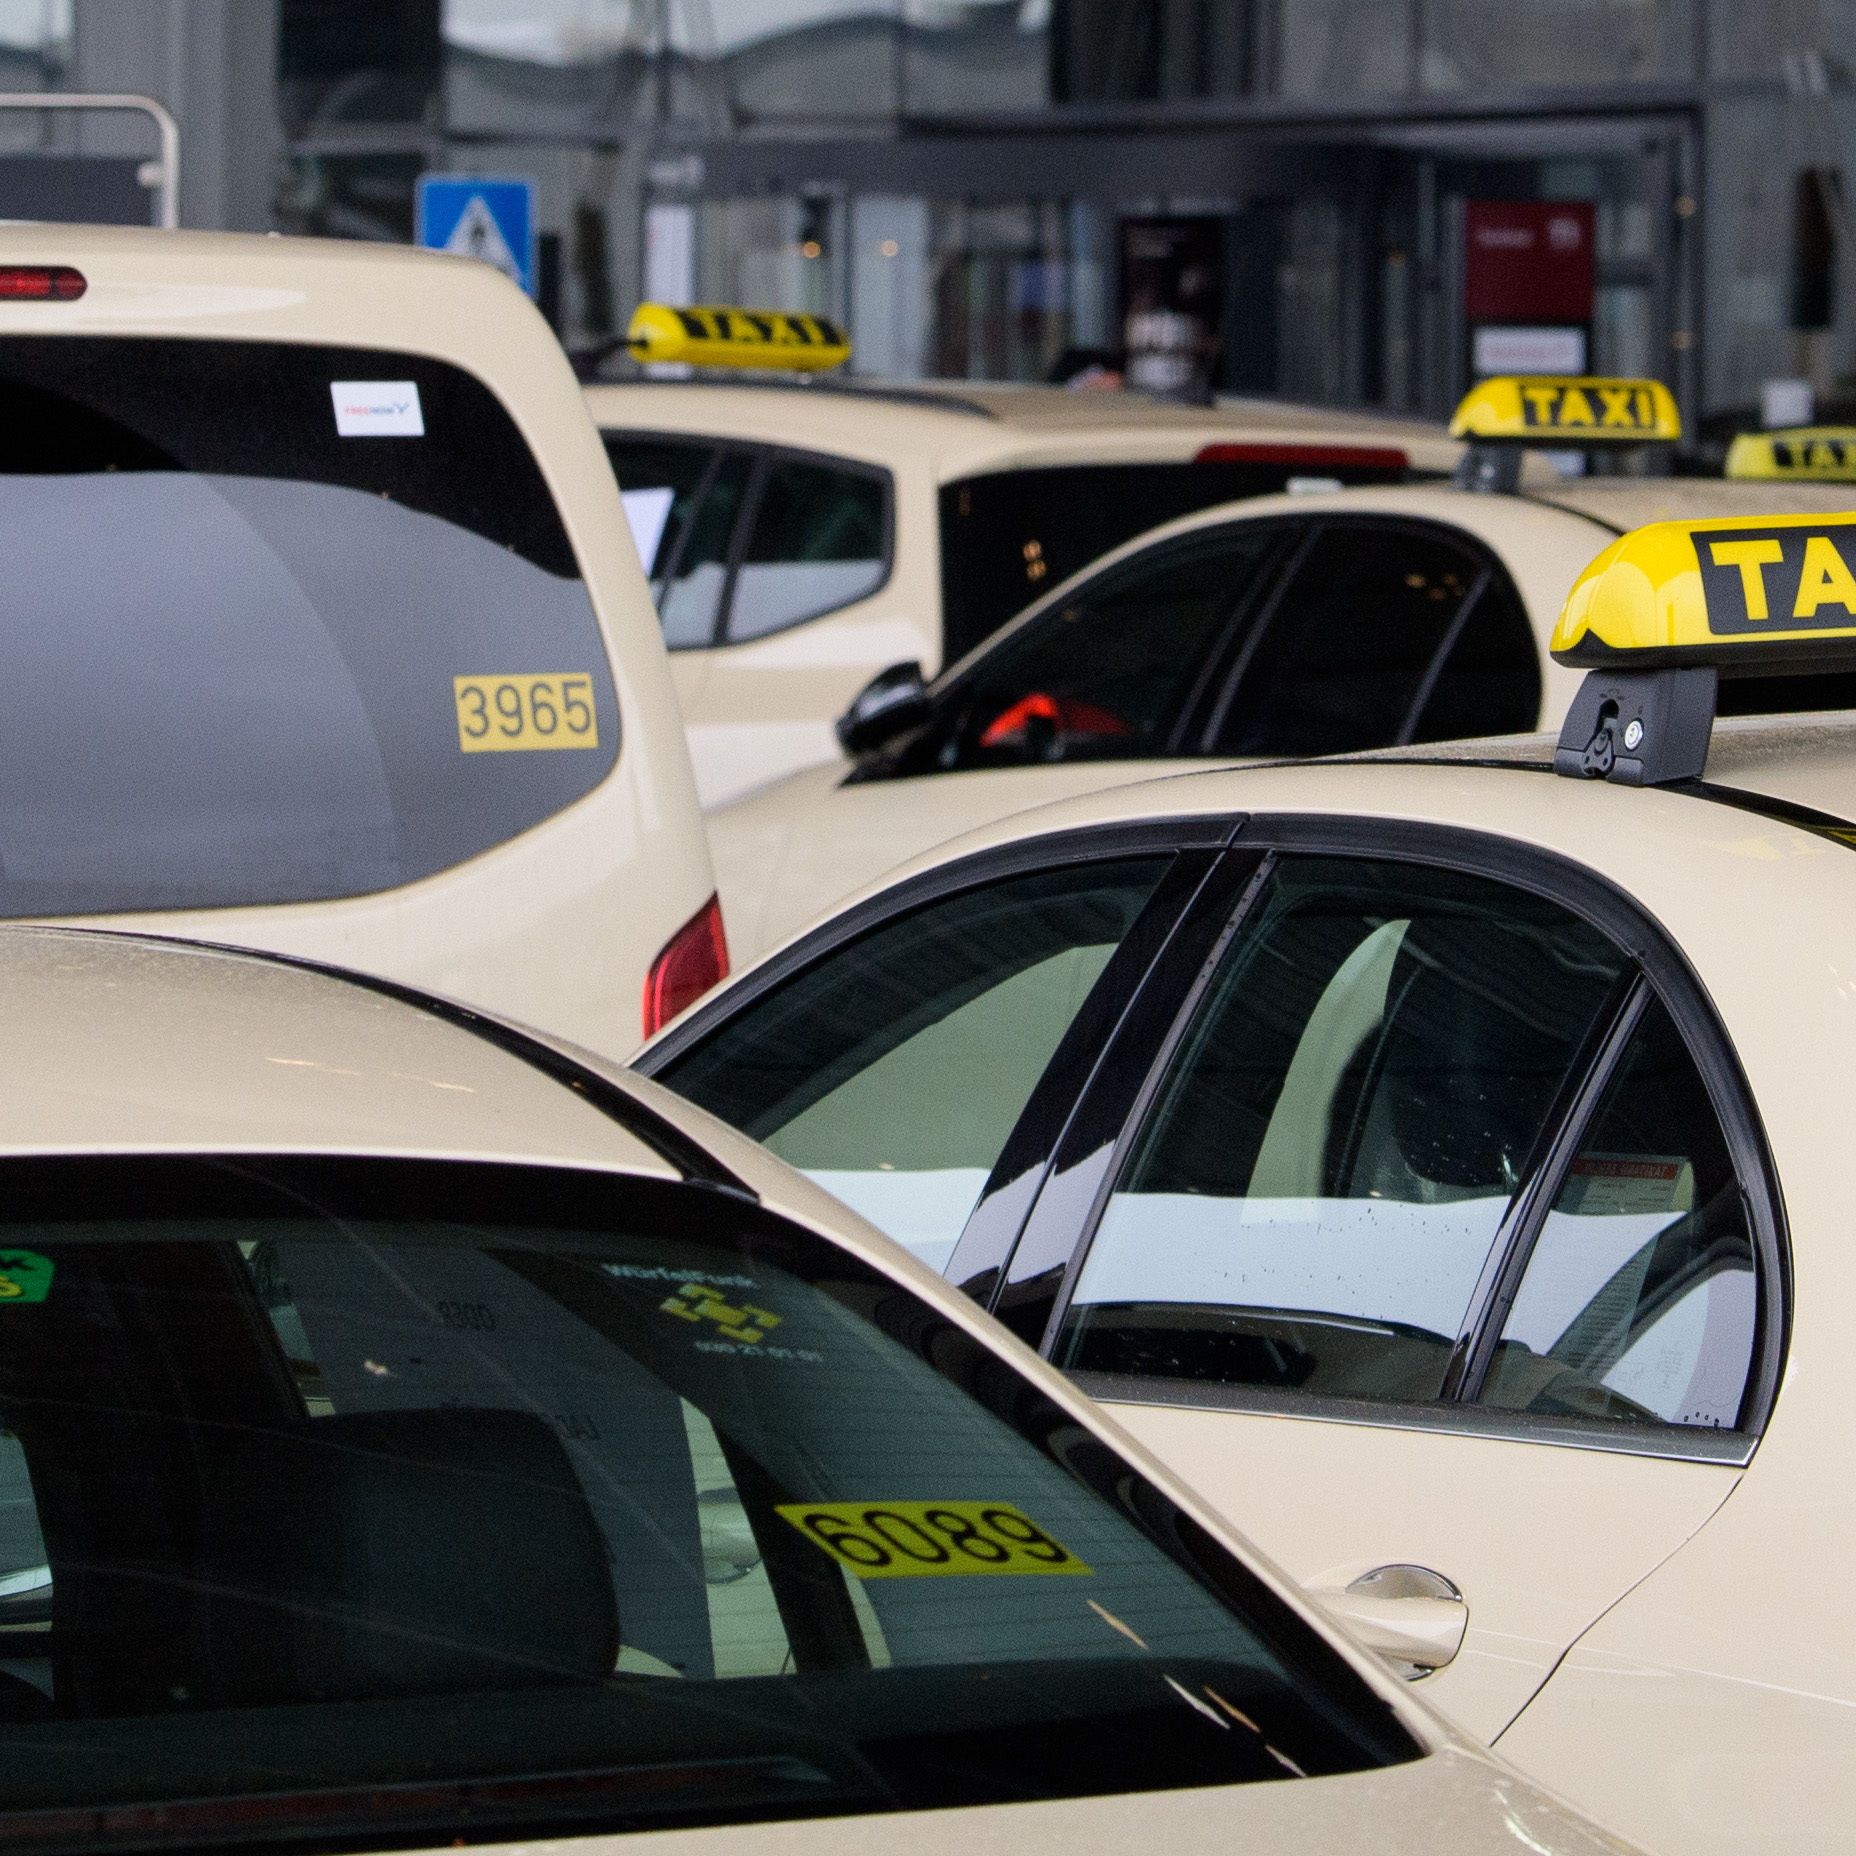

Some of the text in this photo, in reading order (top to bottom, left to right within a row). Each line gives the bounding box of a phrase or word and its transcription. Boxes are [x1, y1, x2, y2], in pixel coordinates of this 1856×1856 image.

[1524, 387, 1655, 427] TAXI
[459, 680, 593, 738] 3965
[802, 1510, 1070, 1567] 6089
